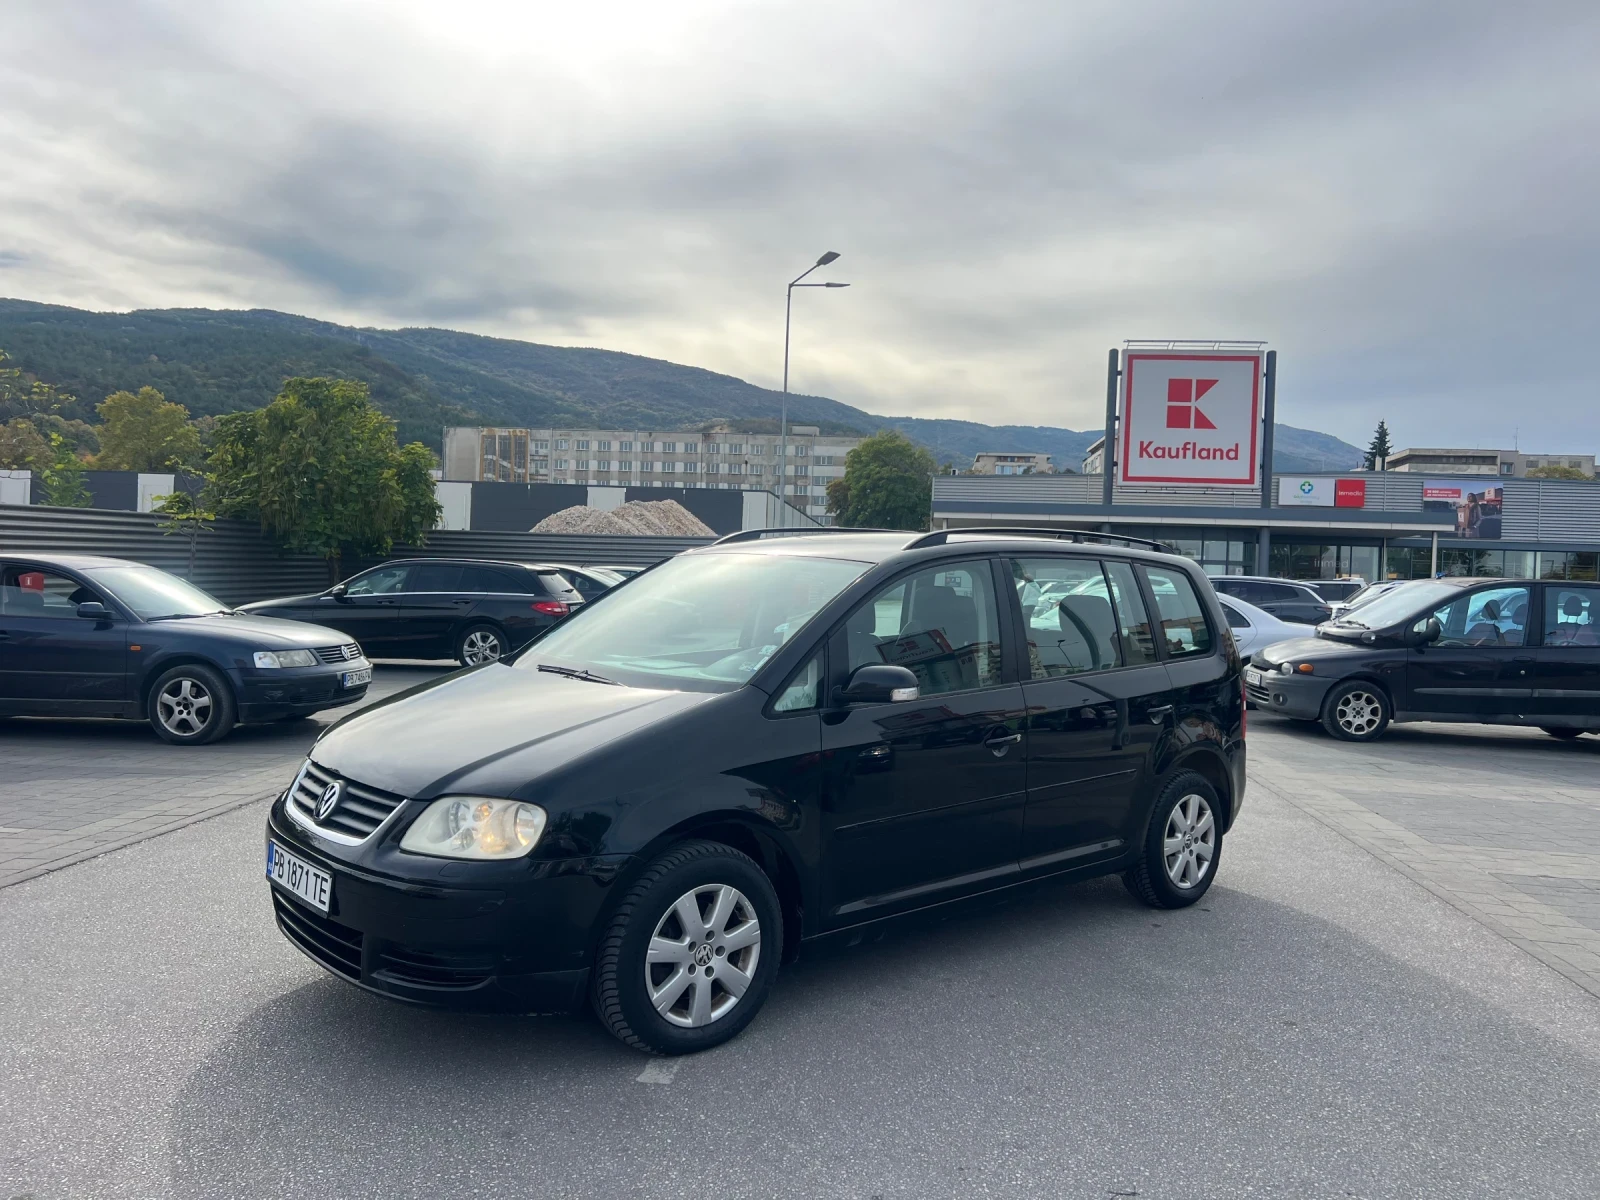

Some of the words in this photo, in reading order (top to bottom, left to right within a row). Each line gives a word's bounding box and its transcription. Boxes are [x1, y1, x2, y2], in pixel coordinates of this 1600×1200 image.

[1138, 440, 1239, 460] Kaufland
[273, 849, 285, 879] PB
[287, 858, 310, 896] 1871
[313, 871, 329, 907] TE
